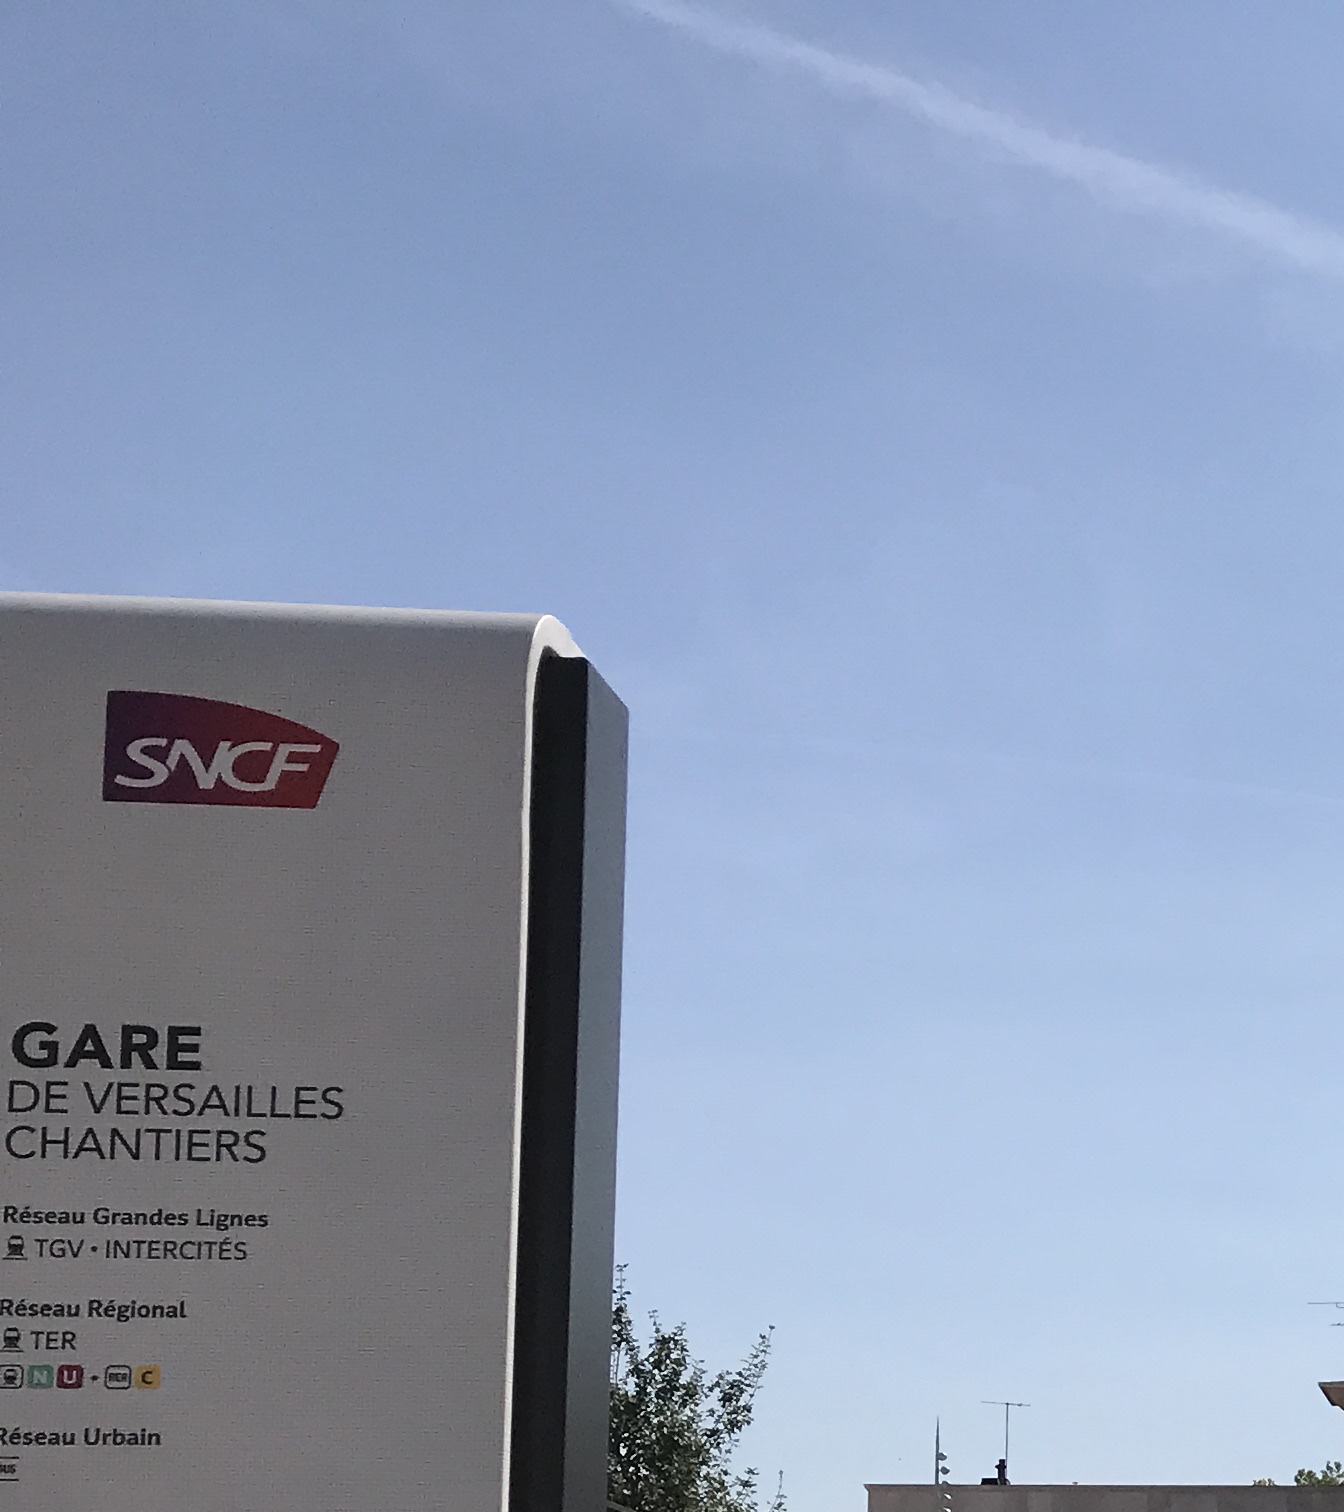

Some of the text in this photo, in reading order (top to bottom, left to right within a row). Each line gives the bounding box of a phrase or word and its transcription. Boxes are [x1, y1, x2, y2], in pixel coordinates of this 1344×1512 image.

[114, 737, 320, 792] SNCF
[11, 1022, 203, 1071] GARE
[6, 1080, 345, 1120] DE VERSAILLES
[5, 1126, 267, 1164] CHANTIERS
[2, 1205, 269, 1231] Réseau Grandes Lignes
[34, 1237, 248, 1261] TGV INTERCITÉS
[0, 1299, 188, 1322] Réseau Régional
[30, 1331, 77, 1350] TER
[32, 1370, 153, 1385] N U RER C
[84, 1427, 162, 1446] Urbain
